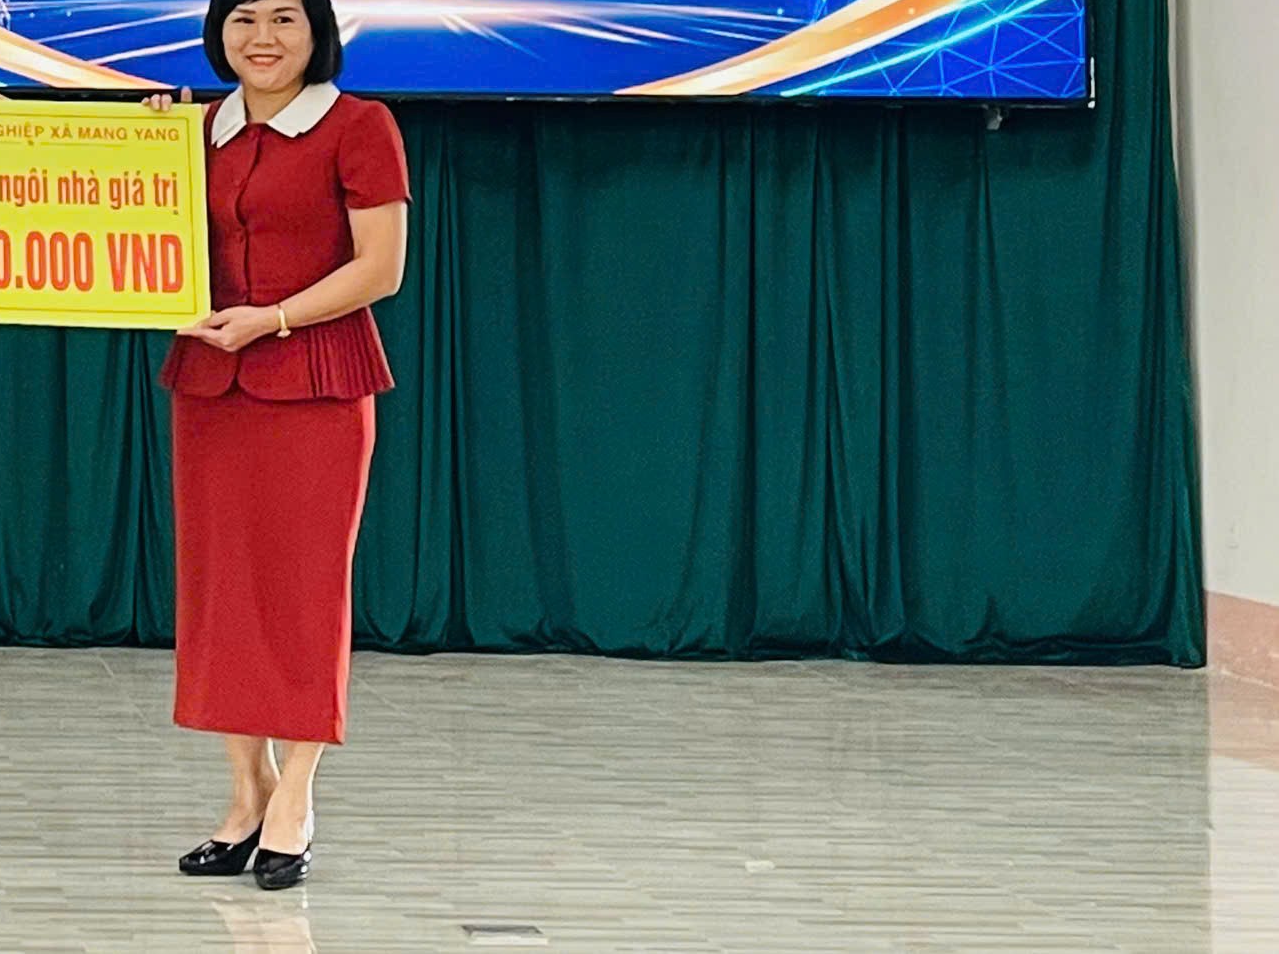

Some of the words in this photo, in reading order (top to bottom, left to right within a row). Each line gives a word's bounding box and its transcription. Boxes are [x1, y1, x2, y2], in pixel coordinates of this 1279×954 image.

[50, 123, 73, 139] XÃ
[78, 126, 128, 140] MANG
[134, 127, 179, 141] YANG
[57, 169, 100, 205] nhà
[109, 170, 145, 210] giá
[153, 172, 179, 215] trị
[106, 232, 185, 294] VND
